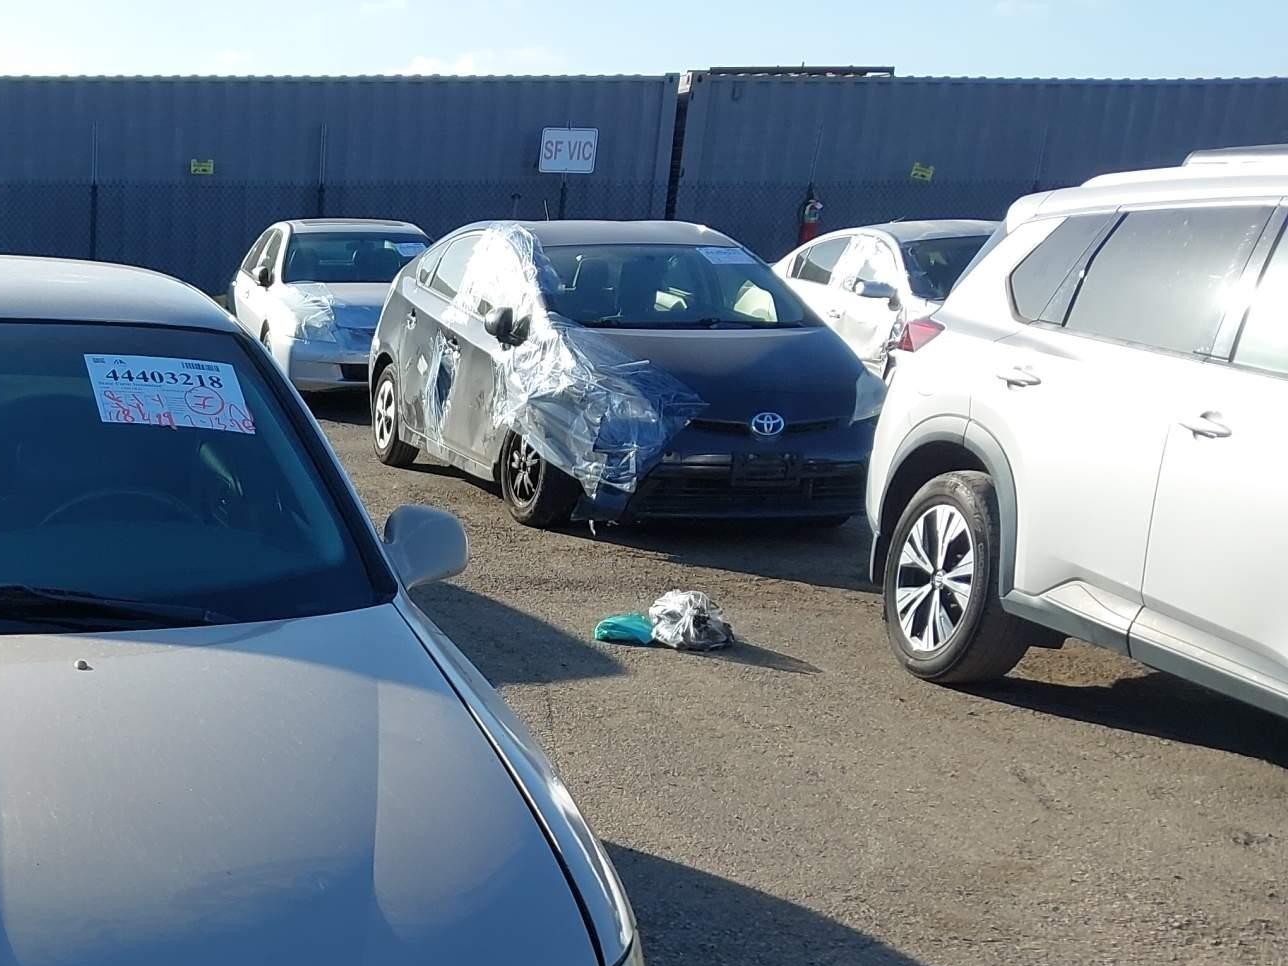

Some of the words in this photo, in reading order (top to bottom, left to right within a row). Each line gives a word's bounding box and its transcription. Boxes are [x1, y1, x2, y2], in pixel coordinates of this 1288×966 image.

[543, 140, 564, 160] SF
[567, 140, 593, 160] VIC
[105, 368, 224, 390] 44403218
